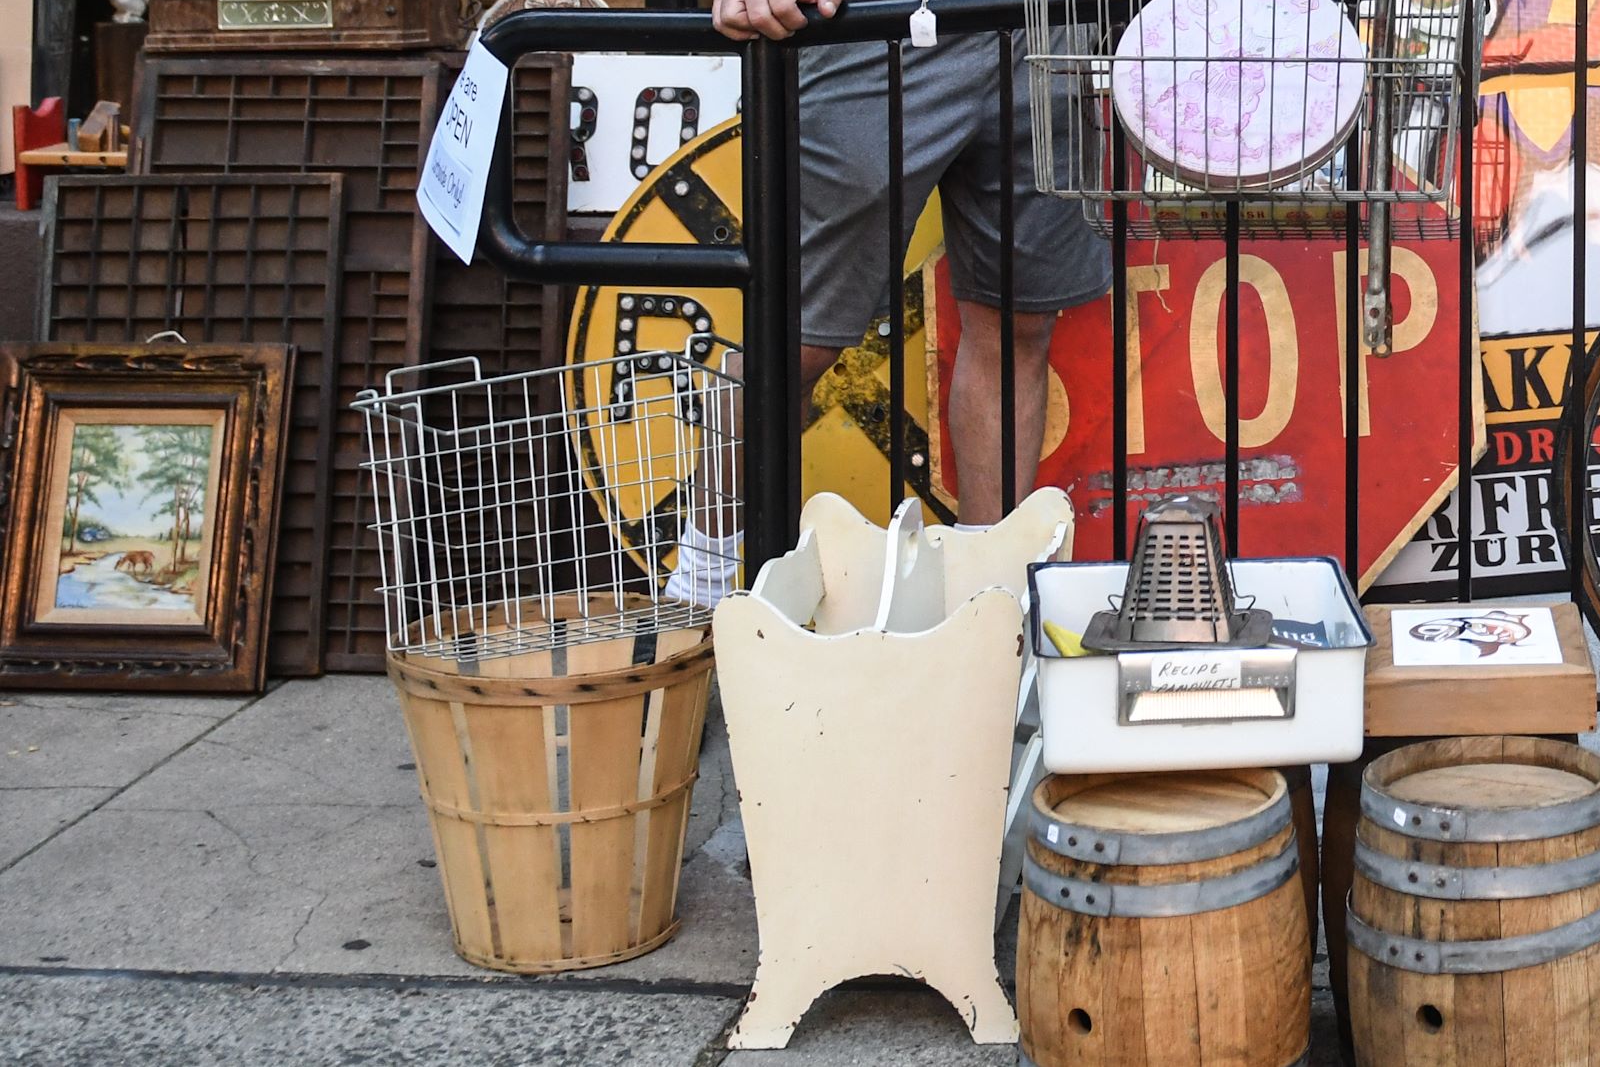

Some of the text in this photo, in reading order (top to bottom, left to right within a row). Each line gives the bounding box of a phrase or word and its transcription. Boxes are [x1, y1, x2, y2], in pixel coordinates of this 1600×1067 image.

[464, 75, 478, 103] are
[446, 96, 473, 150] OPEN
[1040, 245, 1438, 462] TOP
[1158, 661, 1221, 678] RECIPE
